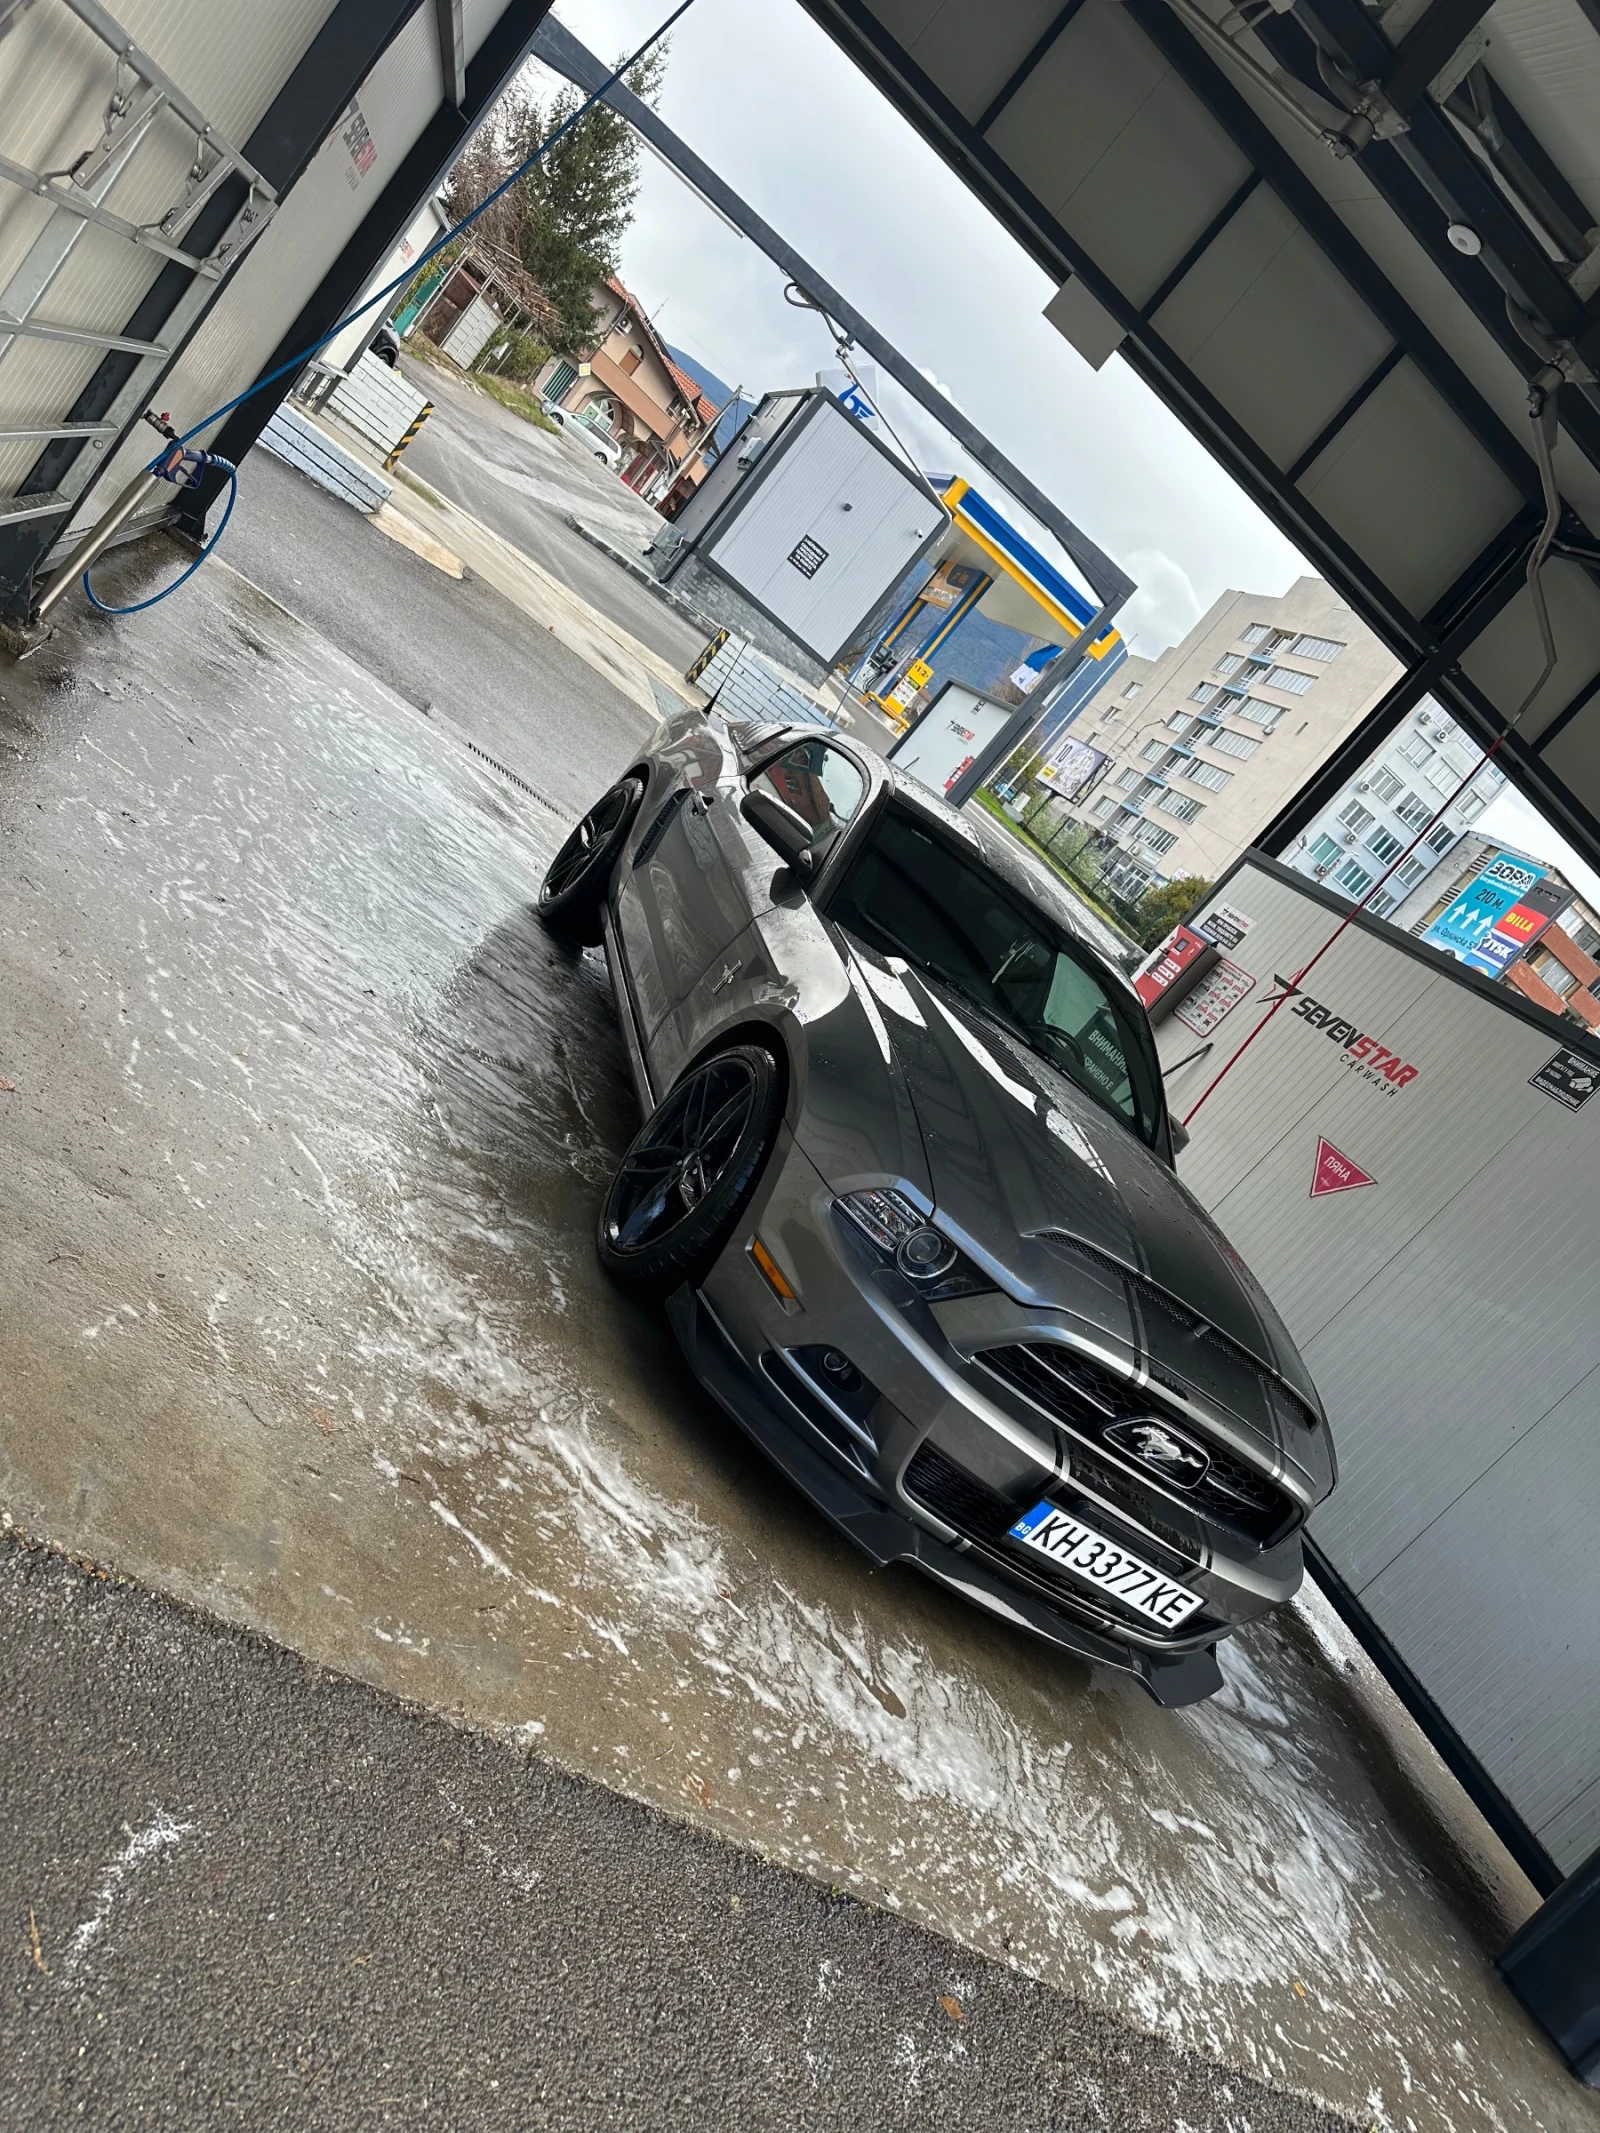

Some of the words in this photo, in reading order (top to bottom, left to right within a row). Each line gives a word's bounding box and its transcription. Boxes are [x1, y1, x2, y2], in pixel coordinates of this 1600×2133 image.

[1475, 888, 1497, 904] 210
[1504, 911, 1535, 933] BILLA
[1483, 937, 1514, 960] JYSK
[1291, 996, 1419, 1088] SEVENSTAR
[1339, 1053, 1399, 1098] CARWASH
[1567, 1056, 1600, 1079] ВНИМАНИЕ
[1105, 1080, 1115, 1090] Е
[1534, 1075, 1580, 1106] ВИДЕОНАБЛЮДЕНИЕ
[1324, 1155, 1351, 1182] ПЯНА
[1014, 1521, 1032, 1535] BG
